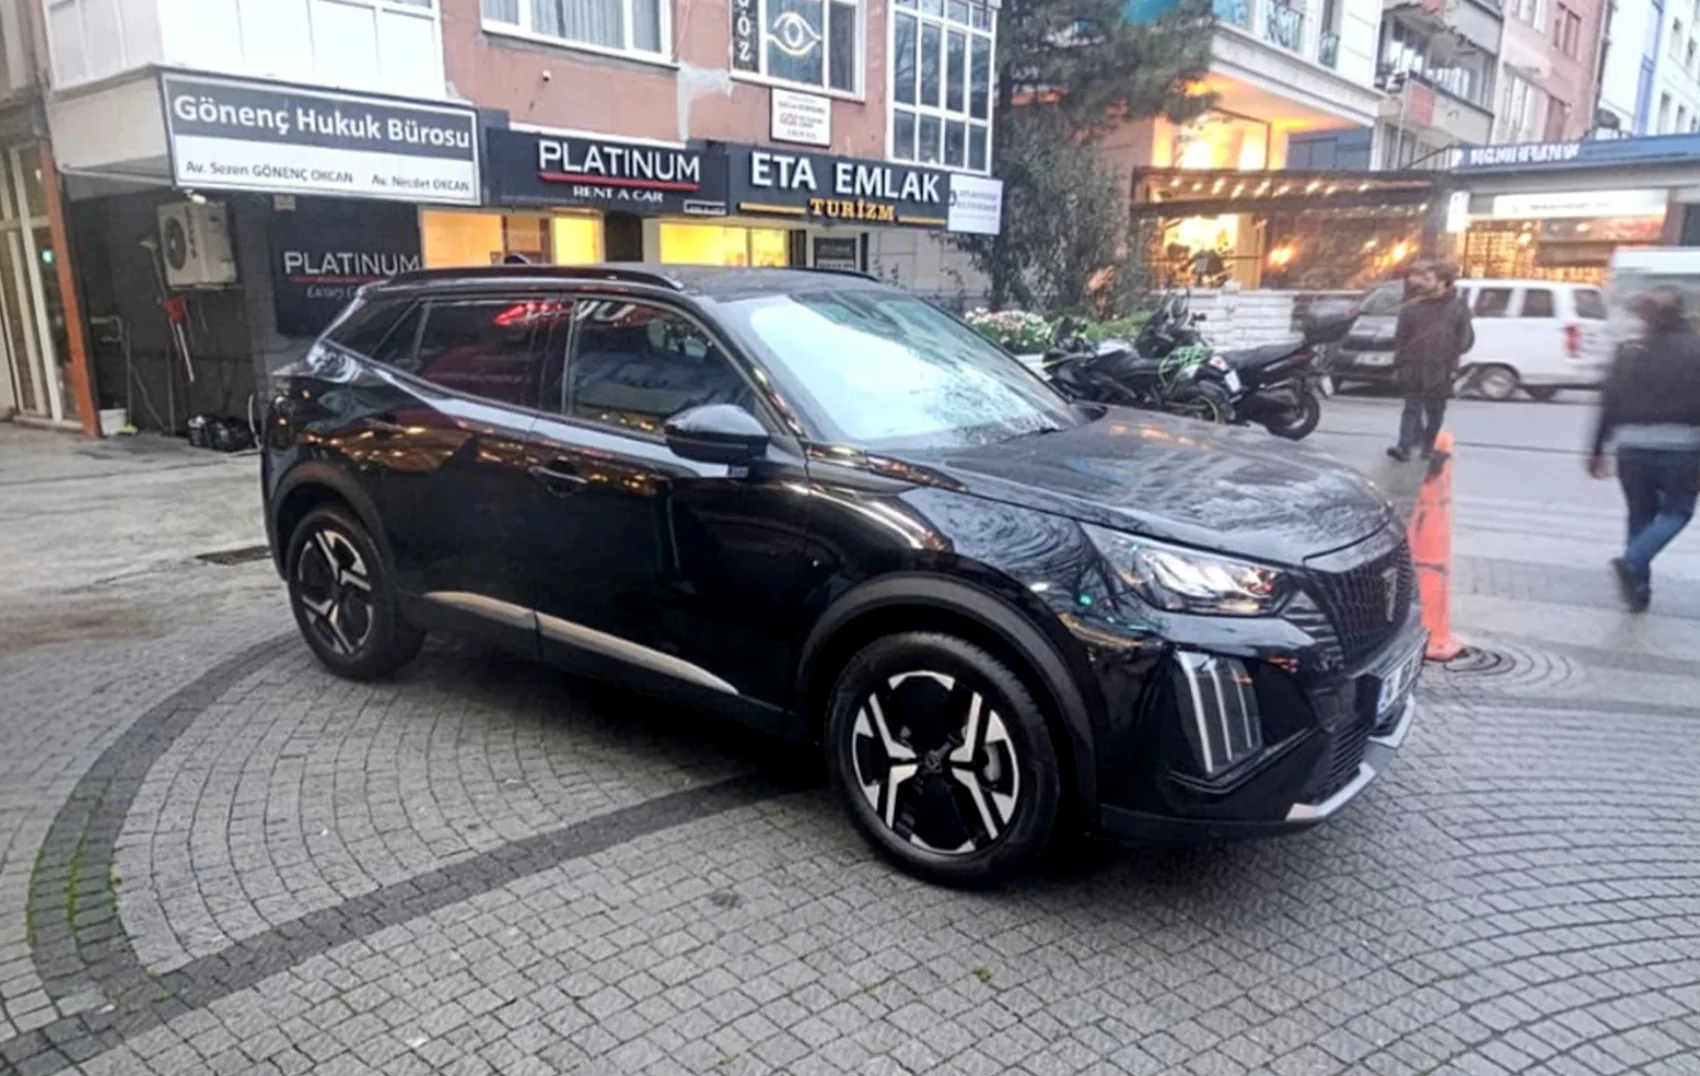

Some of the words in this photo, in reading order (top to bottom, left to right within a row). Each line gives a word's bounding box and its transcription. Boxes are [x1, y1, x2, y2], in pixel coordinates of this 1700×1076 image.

[174, 95, 290, 135] Gönenç
[296, 107, 382, 139] Hukuk
[387, 118, 470, 148] Bürosu
[186, 160, 207, 173] Av.
[252, 163, 308, 181] GÖNENÇ
[538, 140, 700, 182] PLATINUM
[371, 174, 388, 186] Av.
[752, 151, 817, 190] ETA
[835, 162, 940, 203] EMLAK
[573, 185, 615, 200] RENT
[617, 188, 630, 200] A
[632, 190, 664, 202] CAR
[810, 198, 895, 221] TURİZM
[283, 251, 420, 277] PLATINUM
